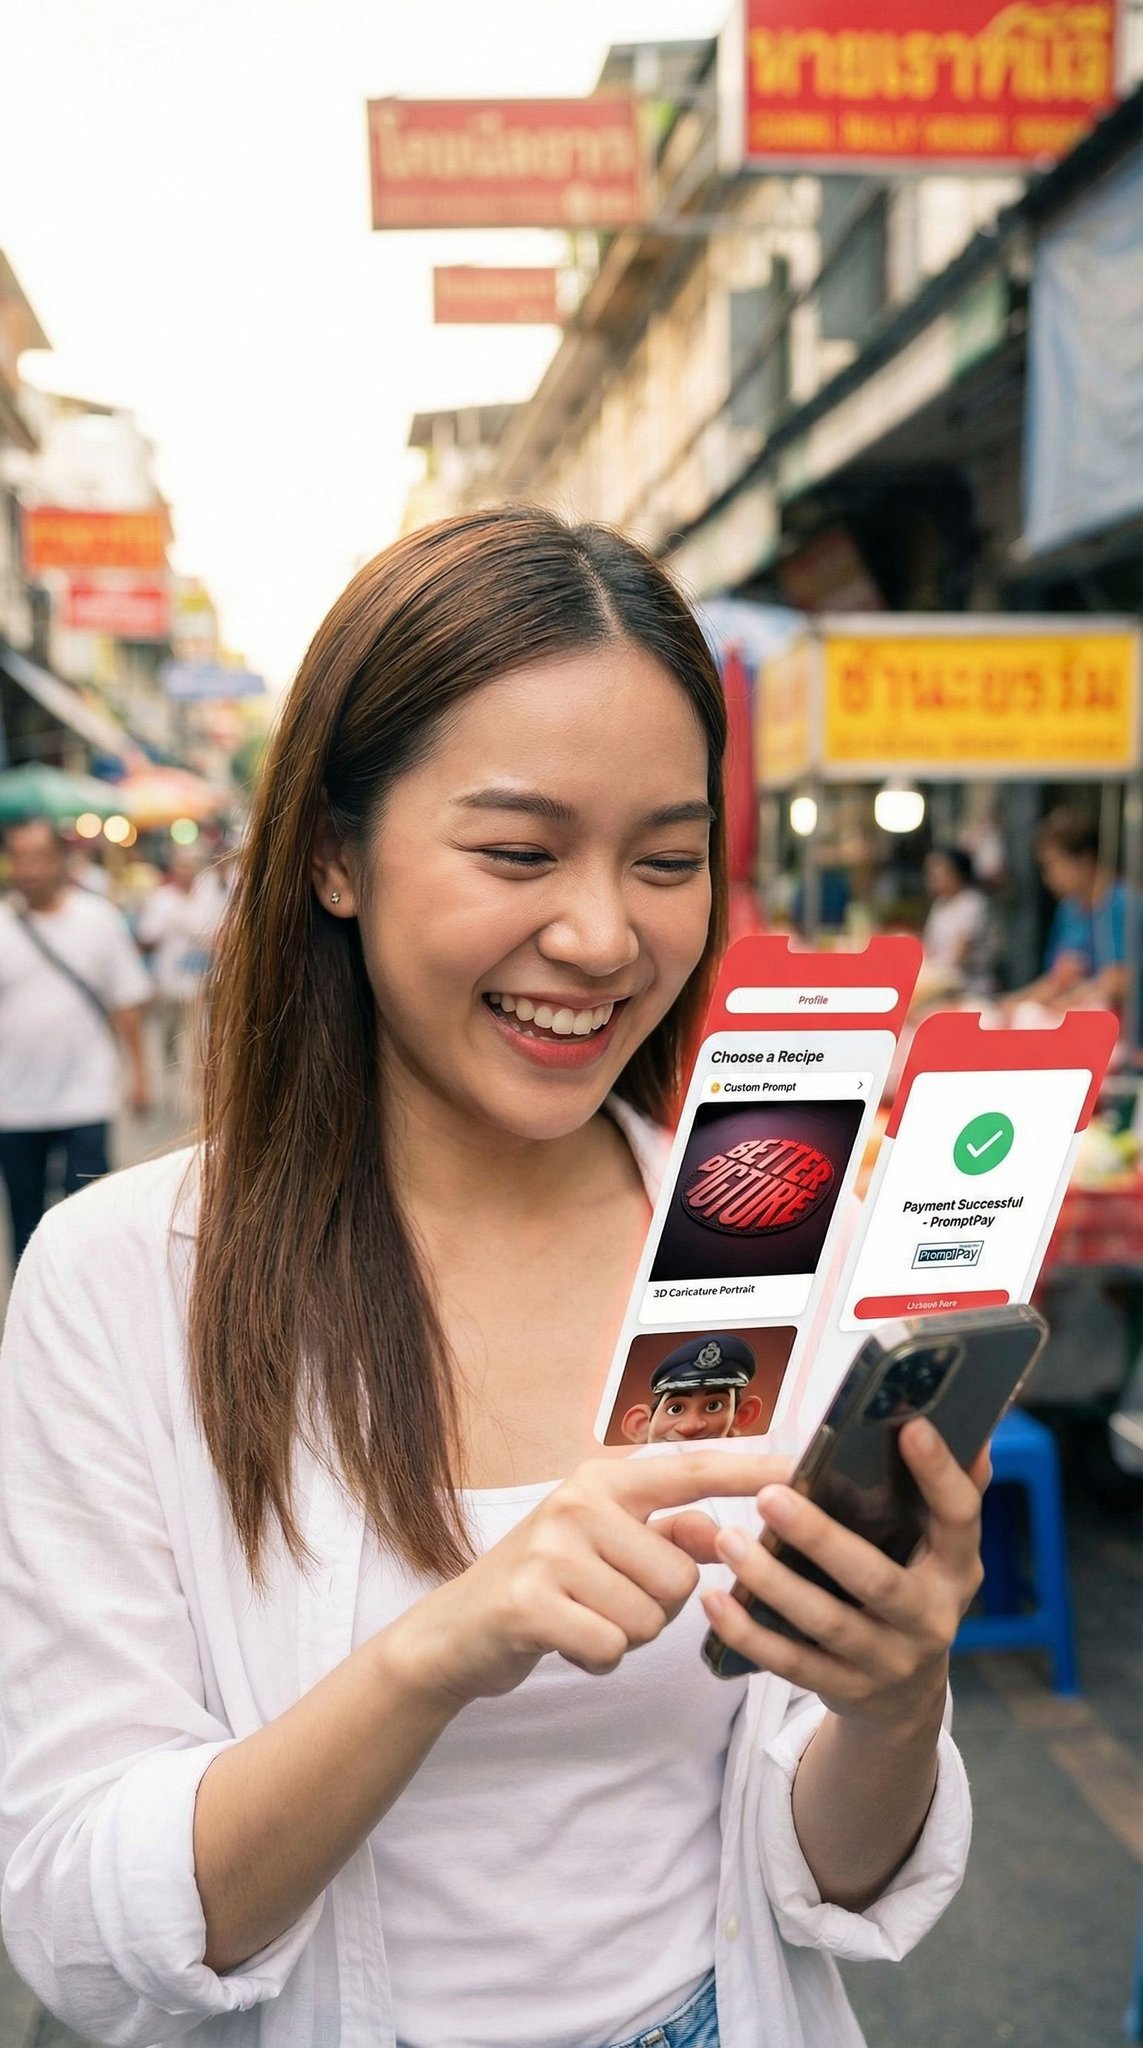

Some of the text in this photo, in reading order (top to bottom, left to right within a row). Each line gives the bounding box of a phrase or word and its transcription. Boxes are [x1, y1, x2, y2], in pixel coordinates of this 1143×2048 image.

[798, 995, 829, 1005] Profile
[711, 1049, 825, 1065] Choose a Recipe
[724, 1082, 797, 1093] Custom Prompt
[725, 1137, 832, 1191] BETTER
[685, 1154, 816, 1229] PICTURE
[902, 1196, 1024, 1215] Payment Successful
[930, 1214, 996, 1229] PromptPay
[653, 1284, 756, 1298] 3D Caricature Portrait
